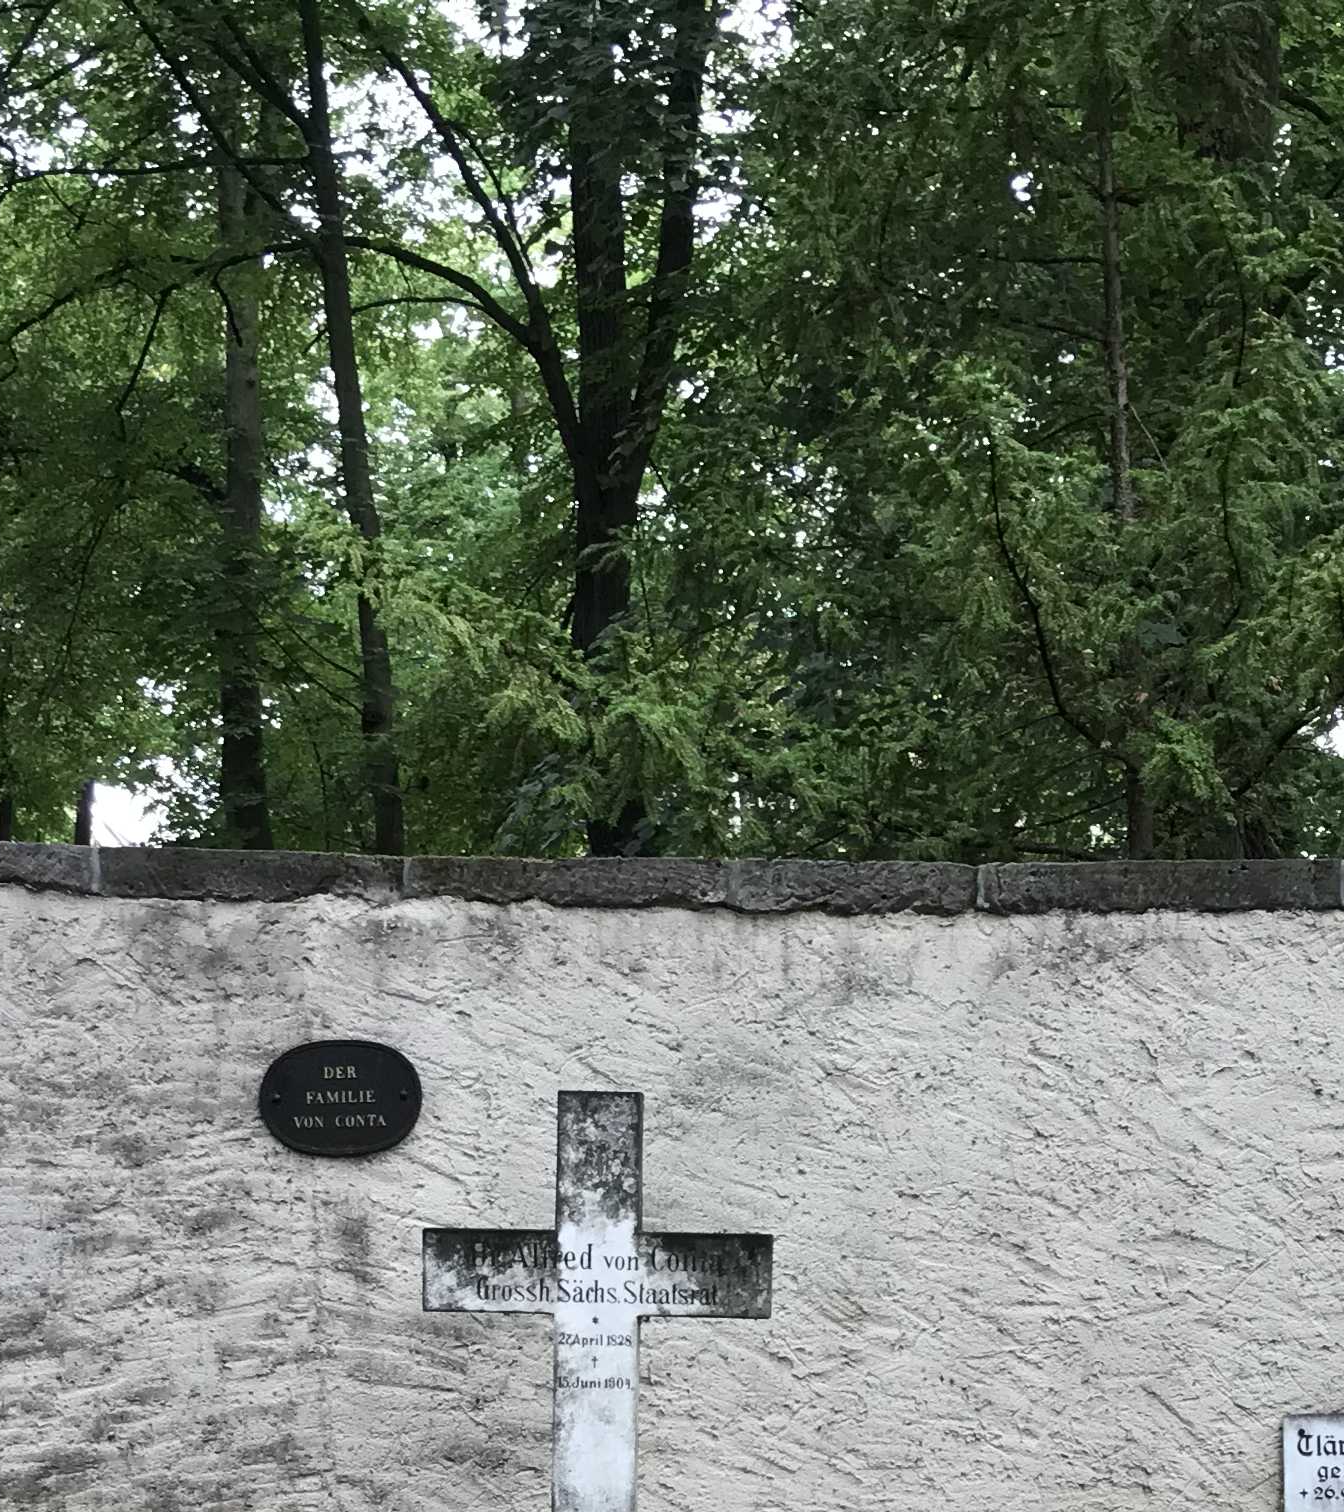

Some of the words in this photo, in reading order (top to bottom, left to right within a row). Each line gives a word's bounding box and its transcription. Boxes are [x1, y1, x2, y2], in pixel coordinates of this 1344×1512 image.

[324, 1066, 356, 1079] DER
[306, 1090, 376, 1104] FAMILIE
[294, 1115, 324, 1128] VON
[336, 1114, 387, 1128] CONTA
[508, 1242, 593, 1270] Alfred
[603, 1255, 639, 1271] von
[623, 1279, 718, 1306] Staatsrat
